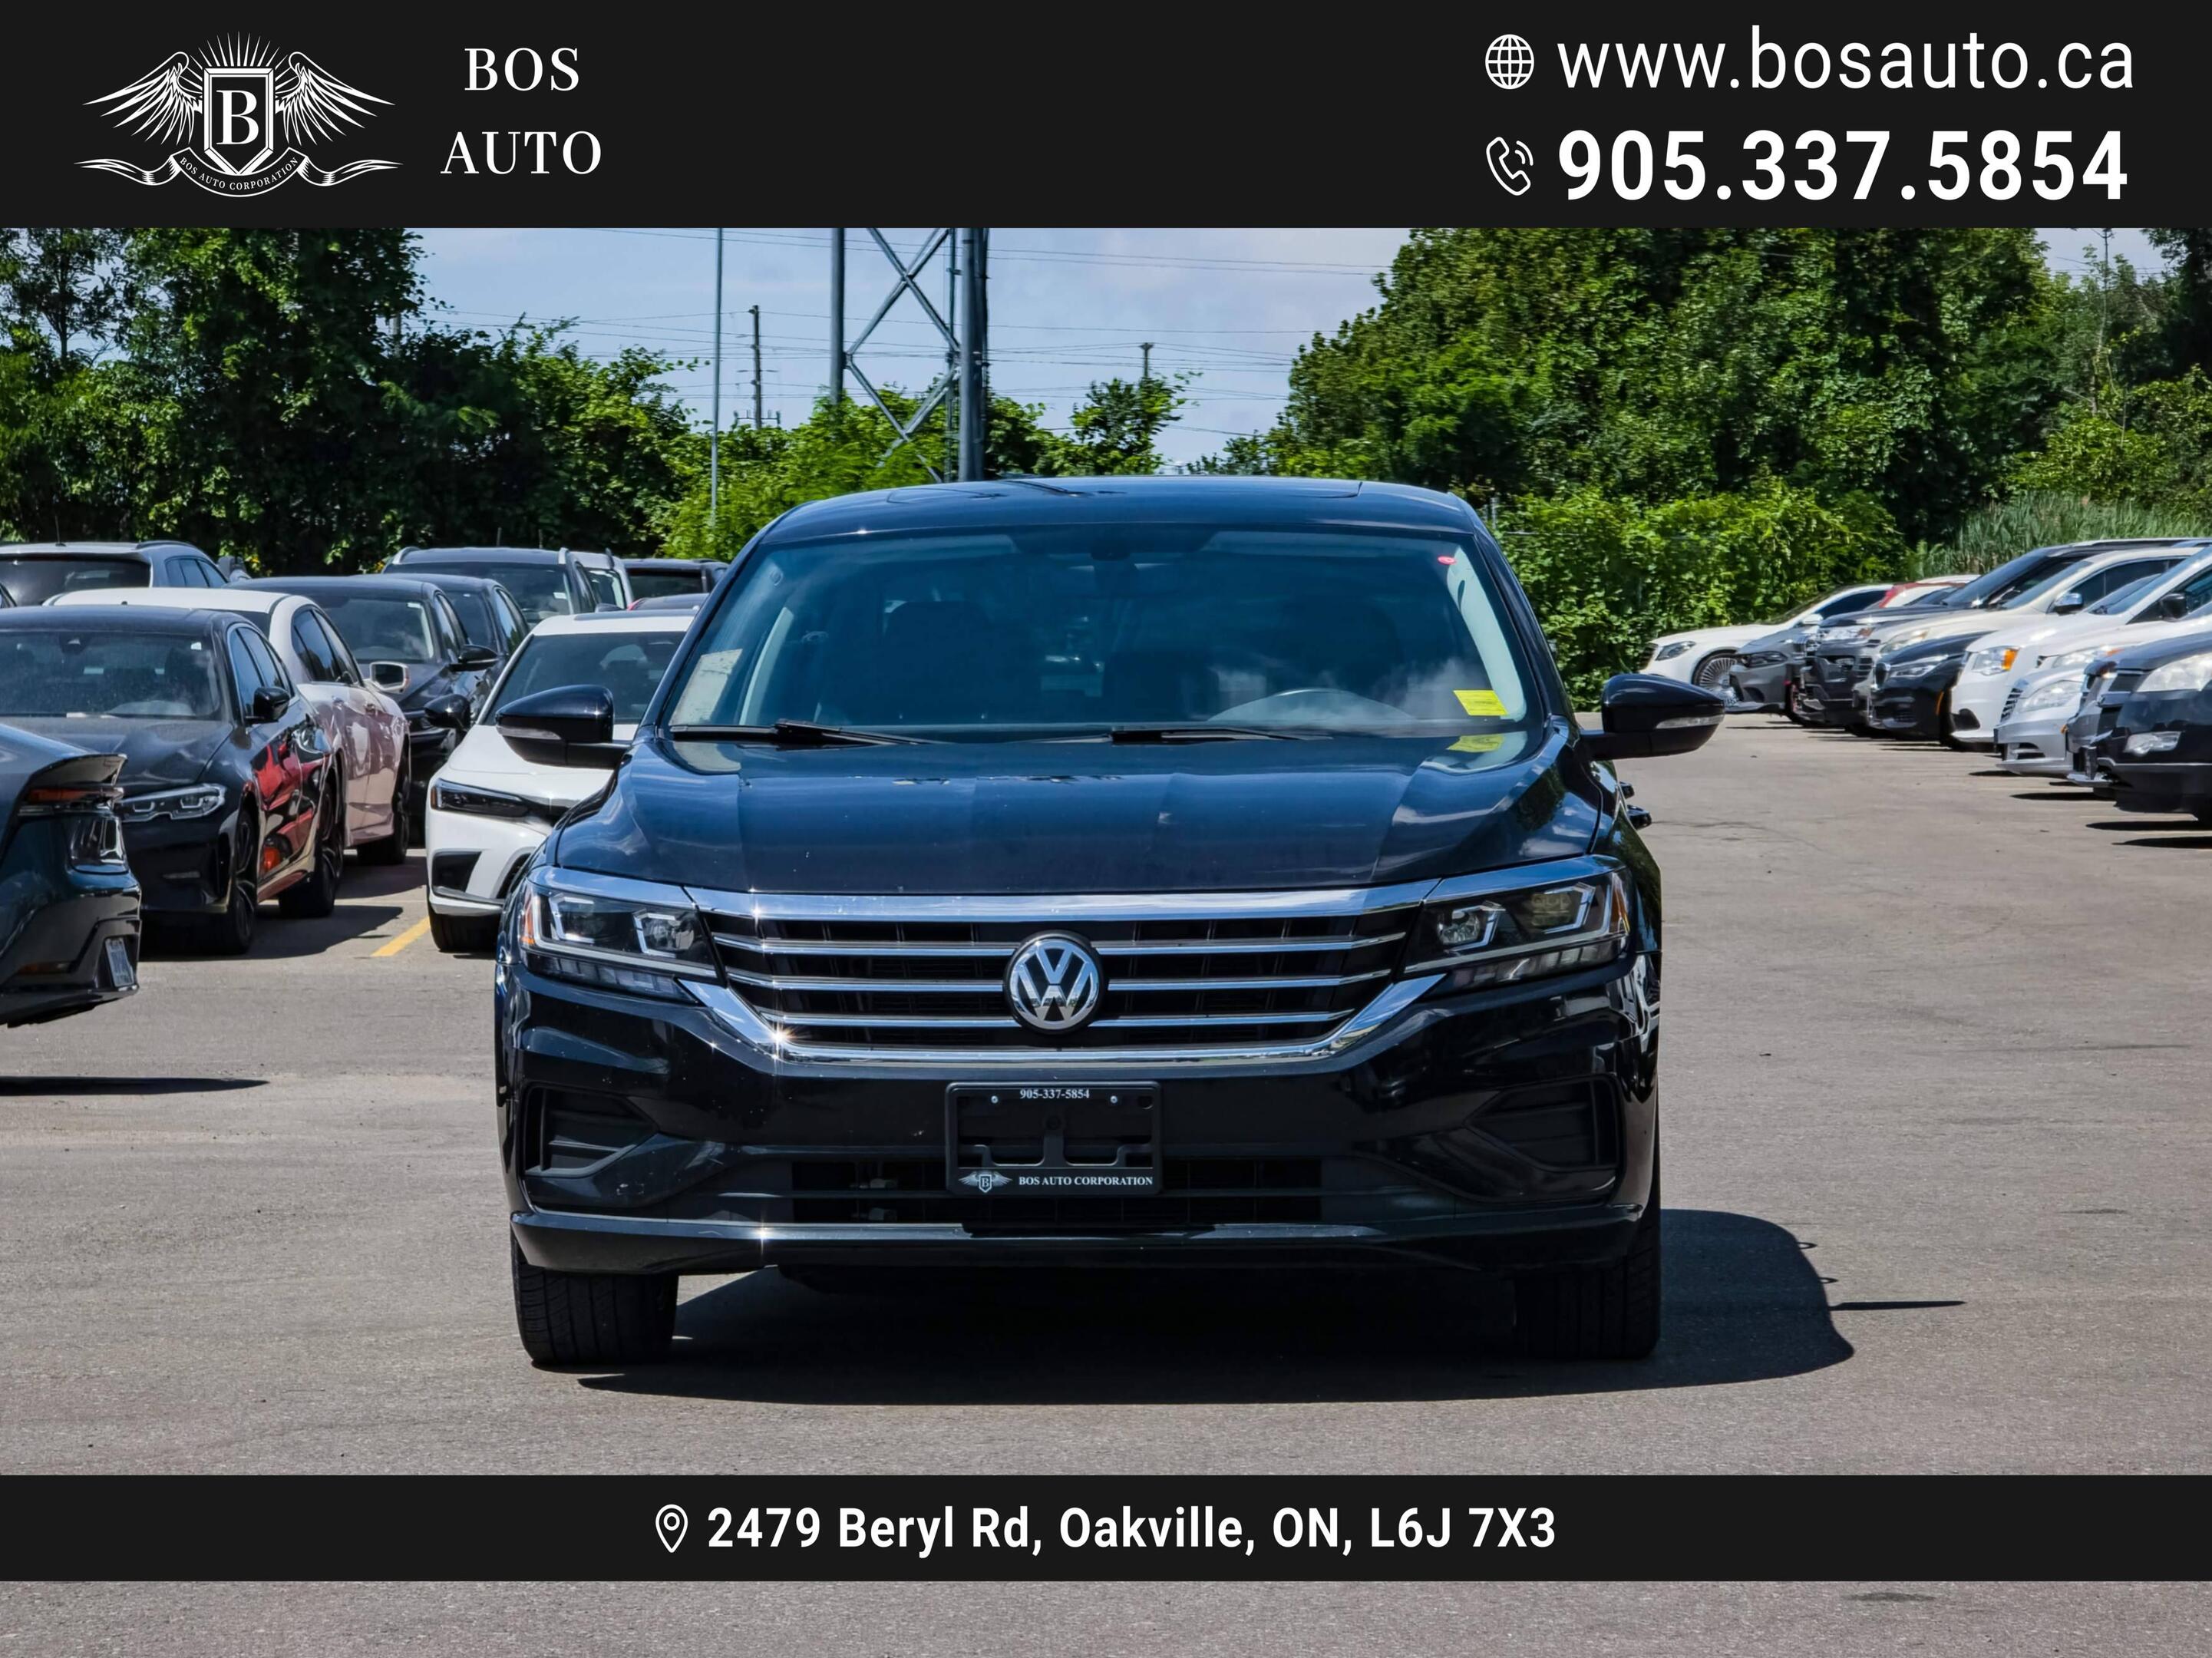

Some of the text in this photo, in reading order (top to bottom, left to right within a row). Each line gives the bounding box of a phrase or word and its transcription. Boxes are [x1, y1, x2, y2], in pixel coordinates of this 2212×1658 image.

[1010, 939, 1099, 1029] VW
[1019, 1089, 1090, 1099] 905-337-5854
[1019, 1176, 1153, 1186] BOS AUTO CORPORATION
